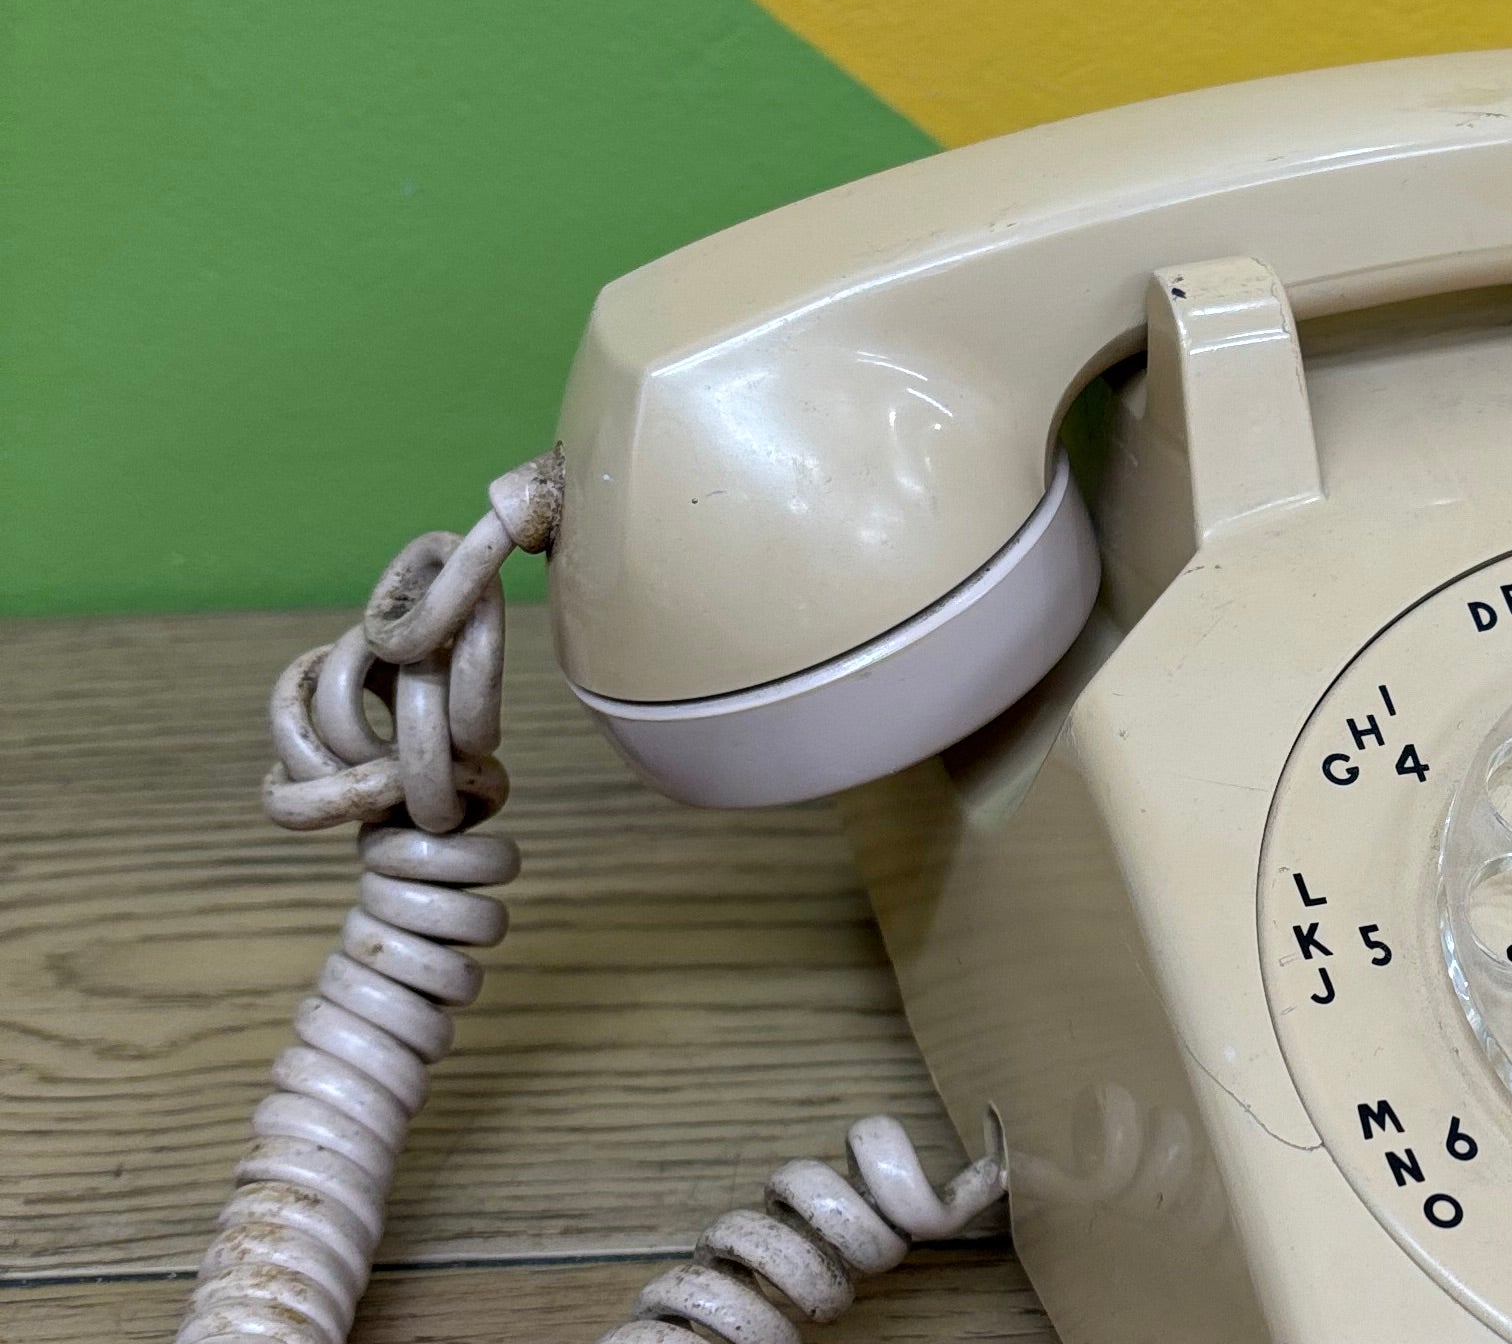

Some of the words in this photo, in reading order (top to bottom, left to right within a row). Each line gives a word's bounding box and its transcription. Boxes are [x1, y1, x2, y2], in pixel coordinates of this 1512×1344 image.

[1394, 743, 1431, 783] 4
[1358, 923, 1393, 967] 5
[1445, 1115, 1479, 1162] 6
